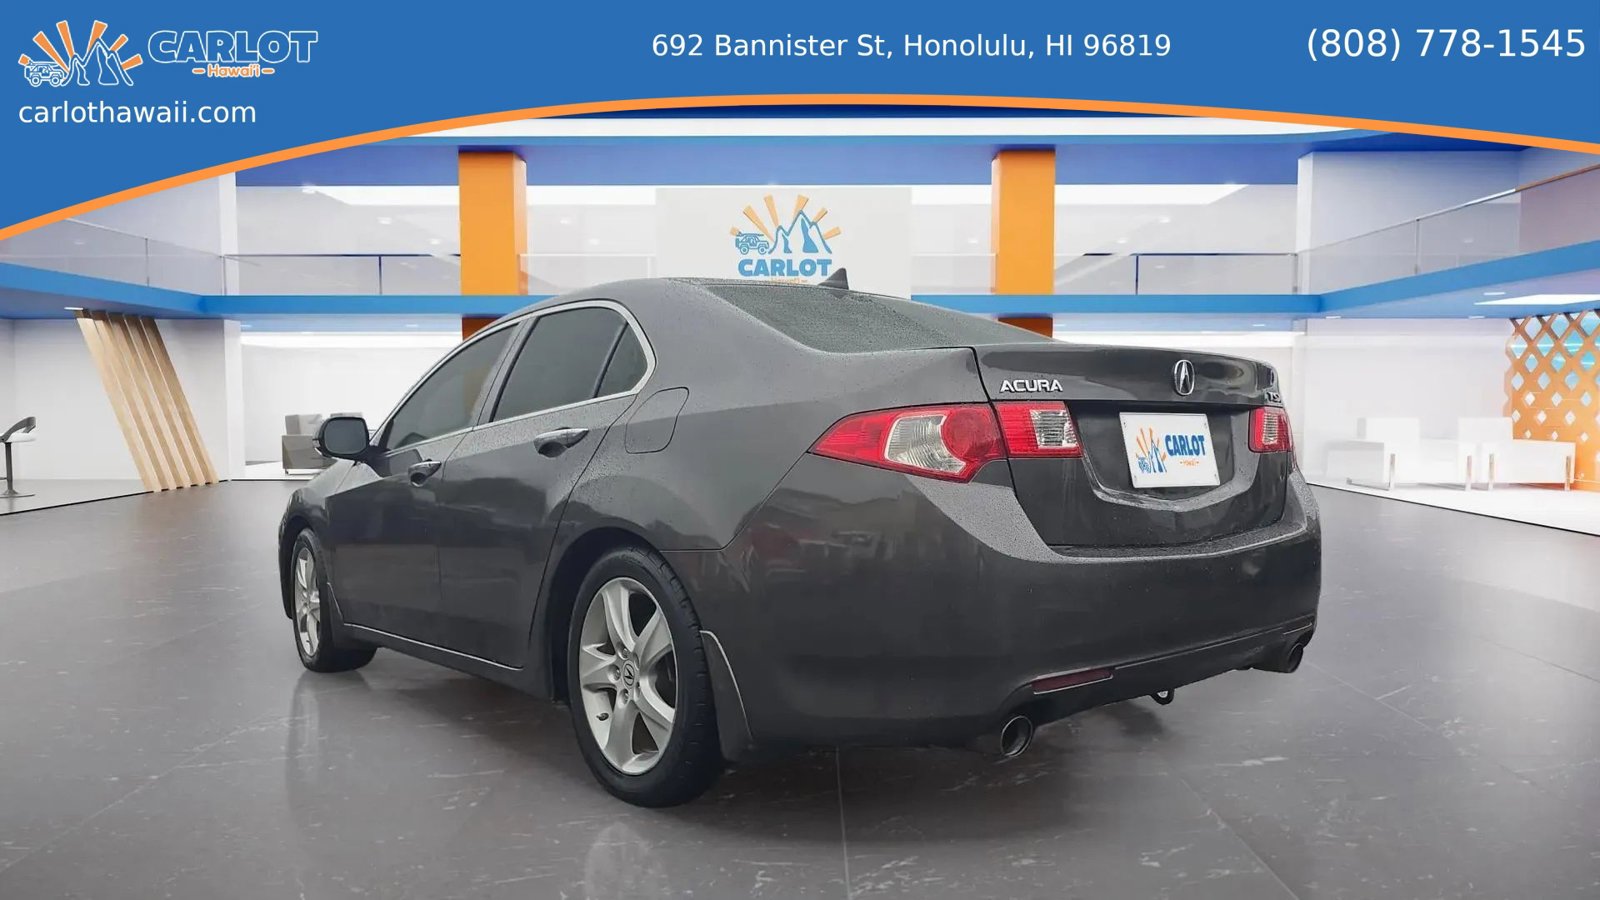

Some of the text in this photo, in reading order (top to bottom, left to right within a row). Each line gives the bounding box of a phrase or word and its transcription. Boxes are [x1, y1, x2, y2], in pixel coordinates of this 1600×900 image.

[738, 258, 832, 277] CARLOT
[1000, 378, 1063, 393] ACURA
[1164, 434, 1206, 457] CARLOT
